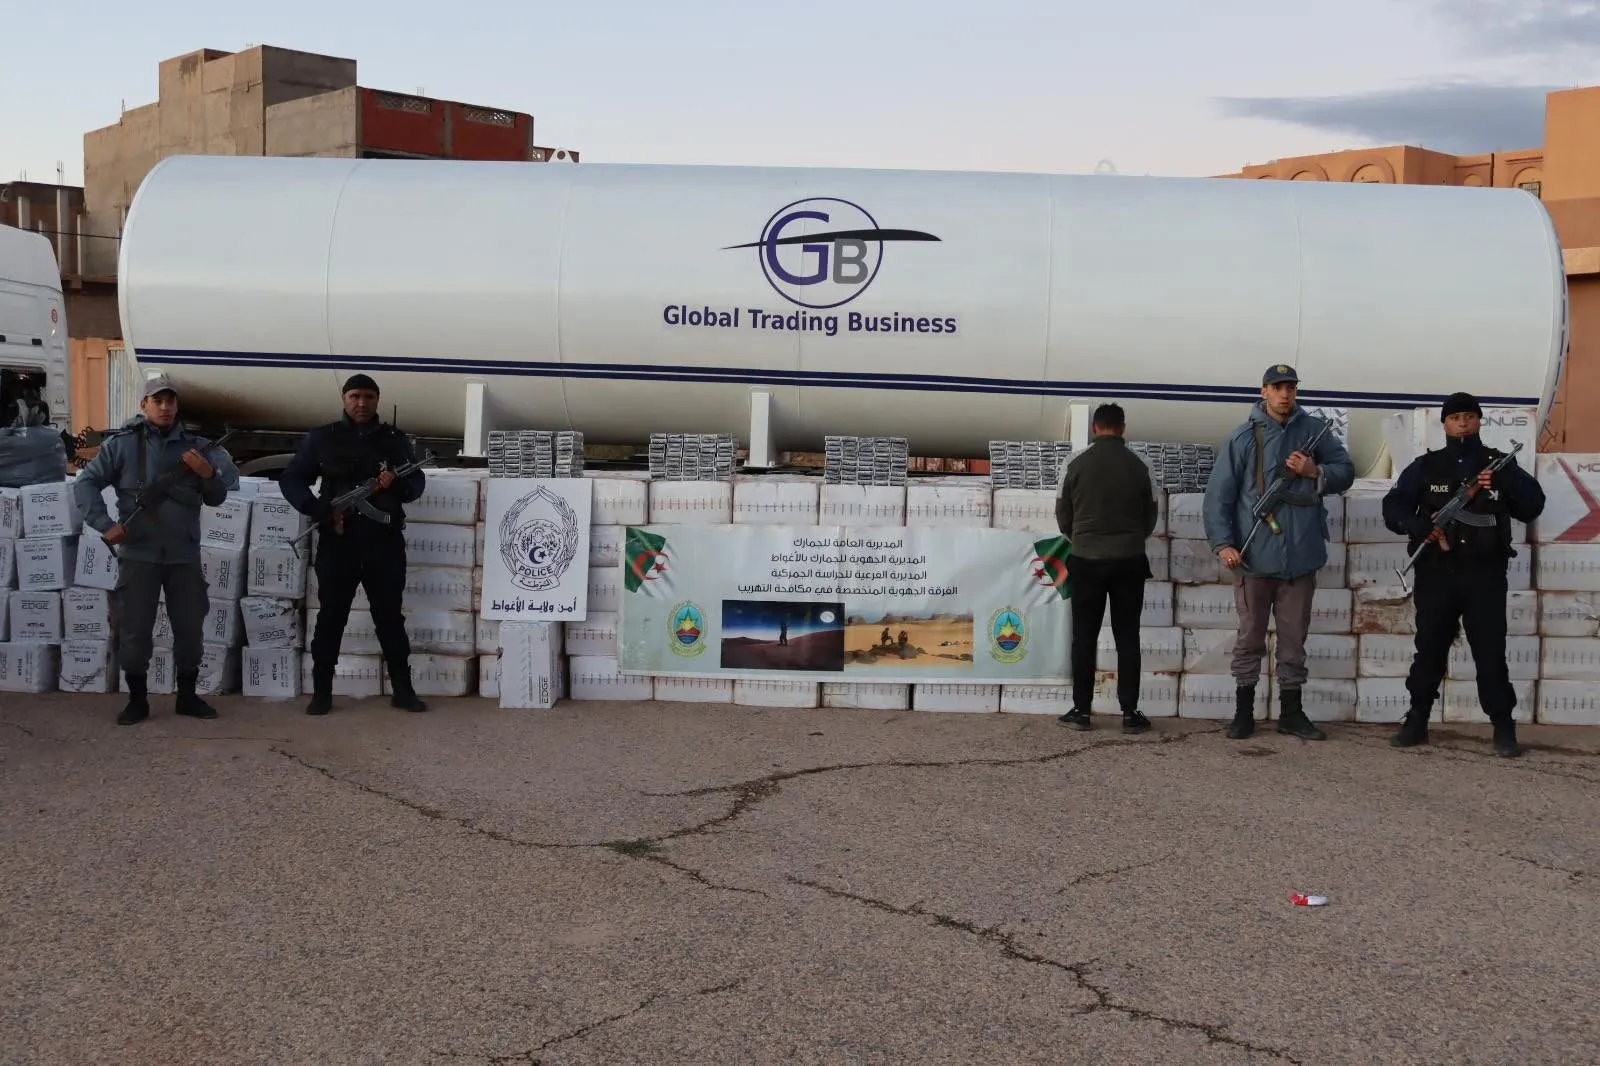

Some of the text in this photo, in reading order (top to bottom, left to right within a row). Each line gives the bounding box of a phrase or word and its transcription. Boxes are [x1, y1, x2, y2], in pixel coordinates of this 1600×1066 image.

[663, 305, 957, 336] Global Trading Business
[1430, 484, 1449, 493] POLICE
[263, 506, 291, 514] EDGE
[208, 529, 235, 541] EDGE
[793, 537, 903, 549] المديرية العامة للجمارك
[86, 546, 96, 575] EDGE
[770, 551, 926, 565] المديرية الجهوية للجمارك بالأغواط
[257, 558, 265, 587] EDGE
[518, 565, 554, 577] POLICE
[771, 568, 813, 580] الجمركية
[855, 570, 888, 581] الفرعية
[890, 570, 927, 581] المديرية
[738, 583, 958, 598] الفرقة الجهوية المتخصصة في مكافحة التهريب
[21, 602, 49, 610] EDGE
[491, 595, 577, 613] أمن ولاية الأغواط
[260, 629, 286, 640] EDGE
[252, 657, 260, 686] EDGE
